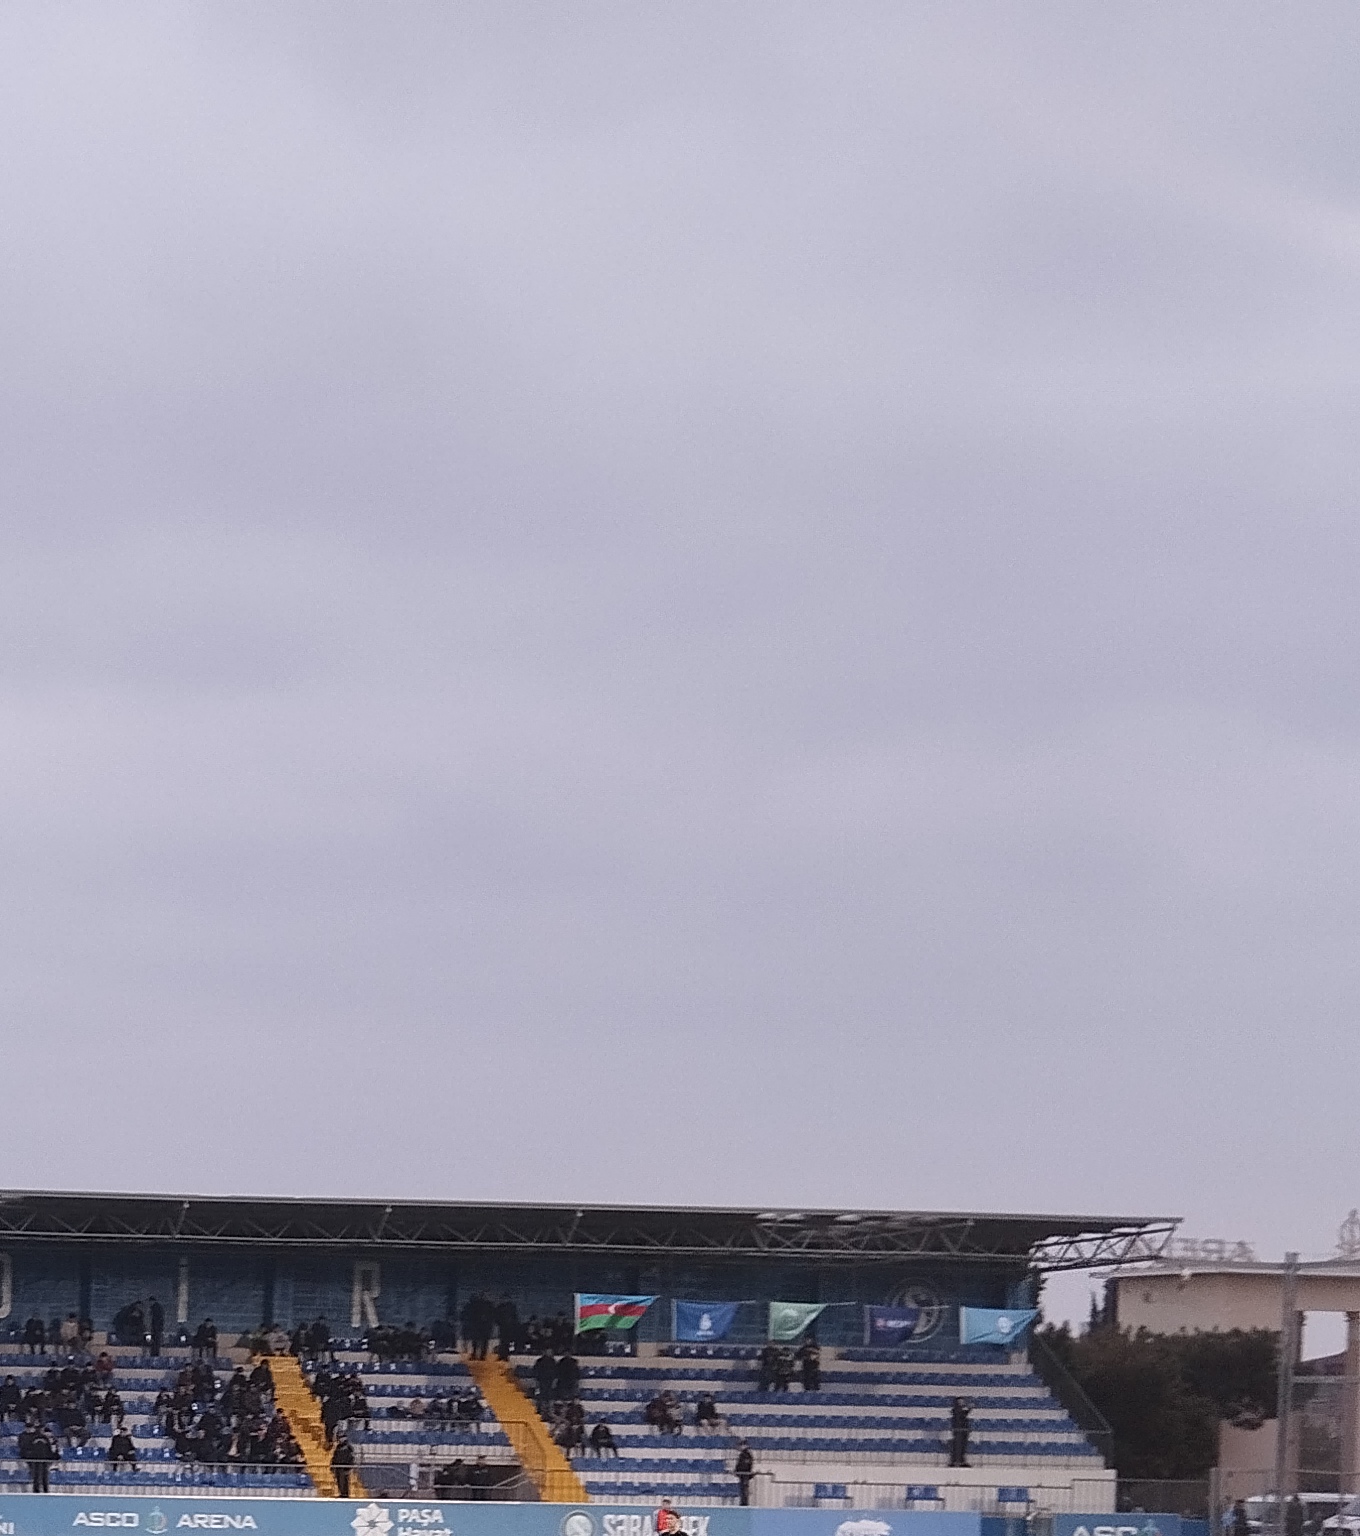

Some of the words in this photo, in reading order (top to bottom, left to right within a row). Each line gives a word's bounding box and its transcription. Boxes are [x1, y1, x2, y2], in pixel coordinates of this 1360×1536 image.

[72, 1512, 139, 1527] ASCO
[176, 1513, 258, 1529] ARENA
[398, 1508, 443, 1527] PAŞA
